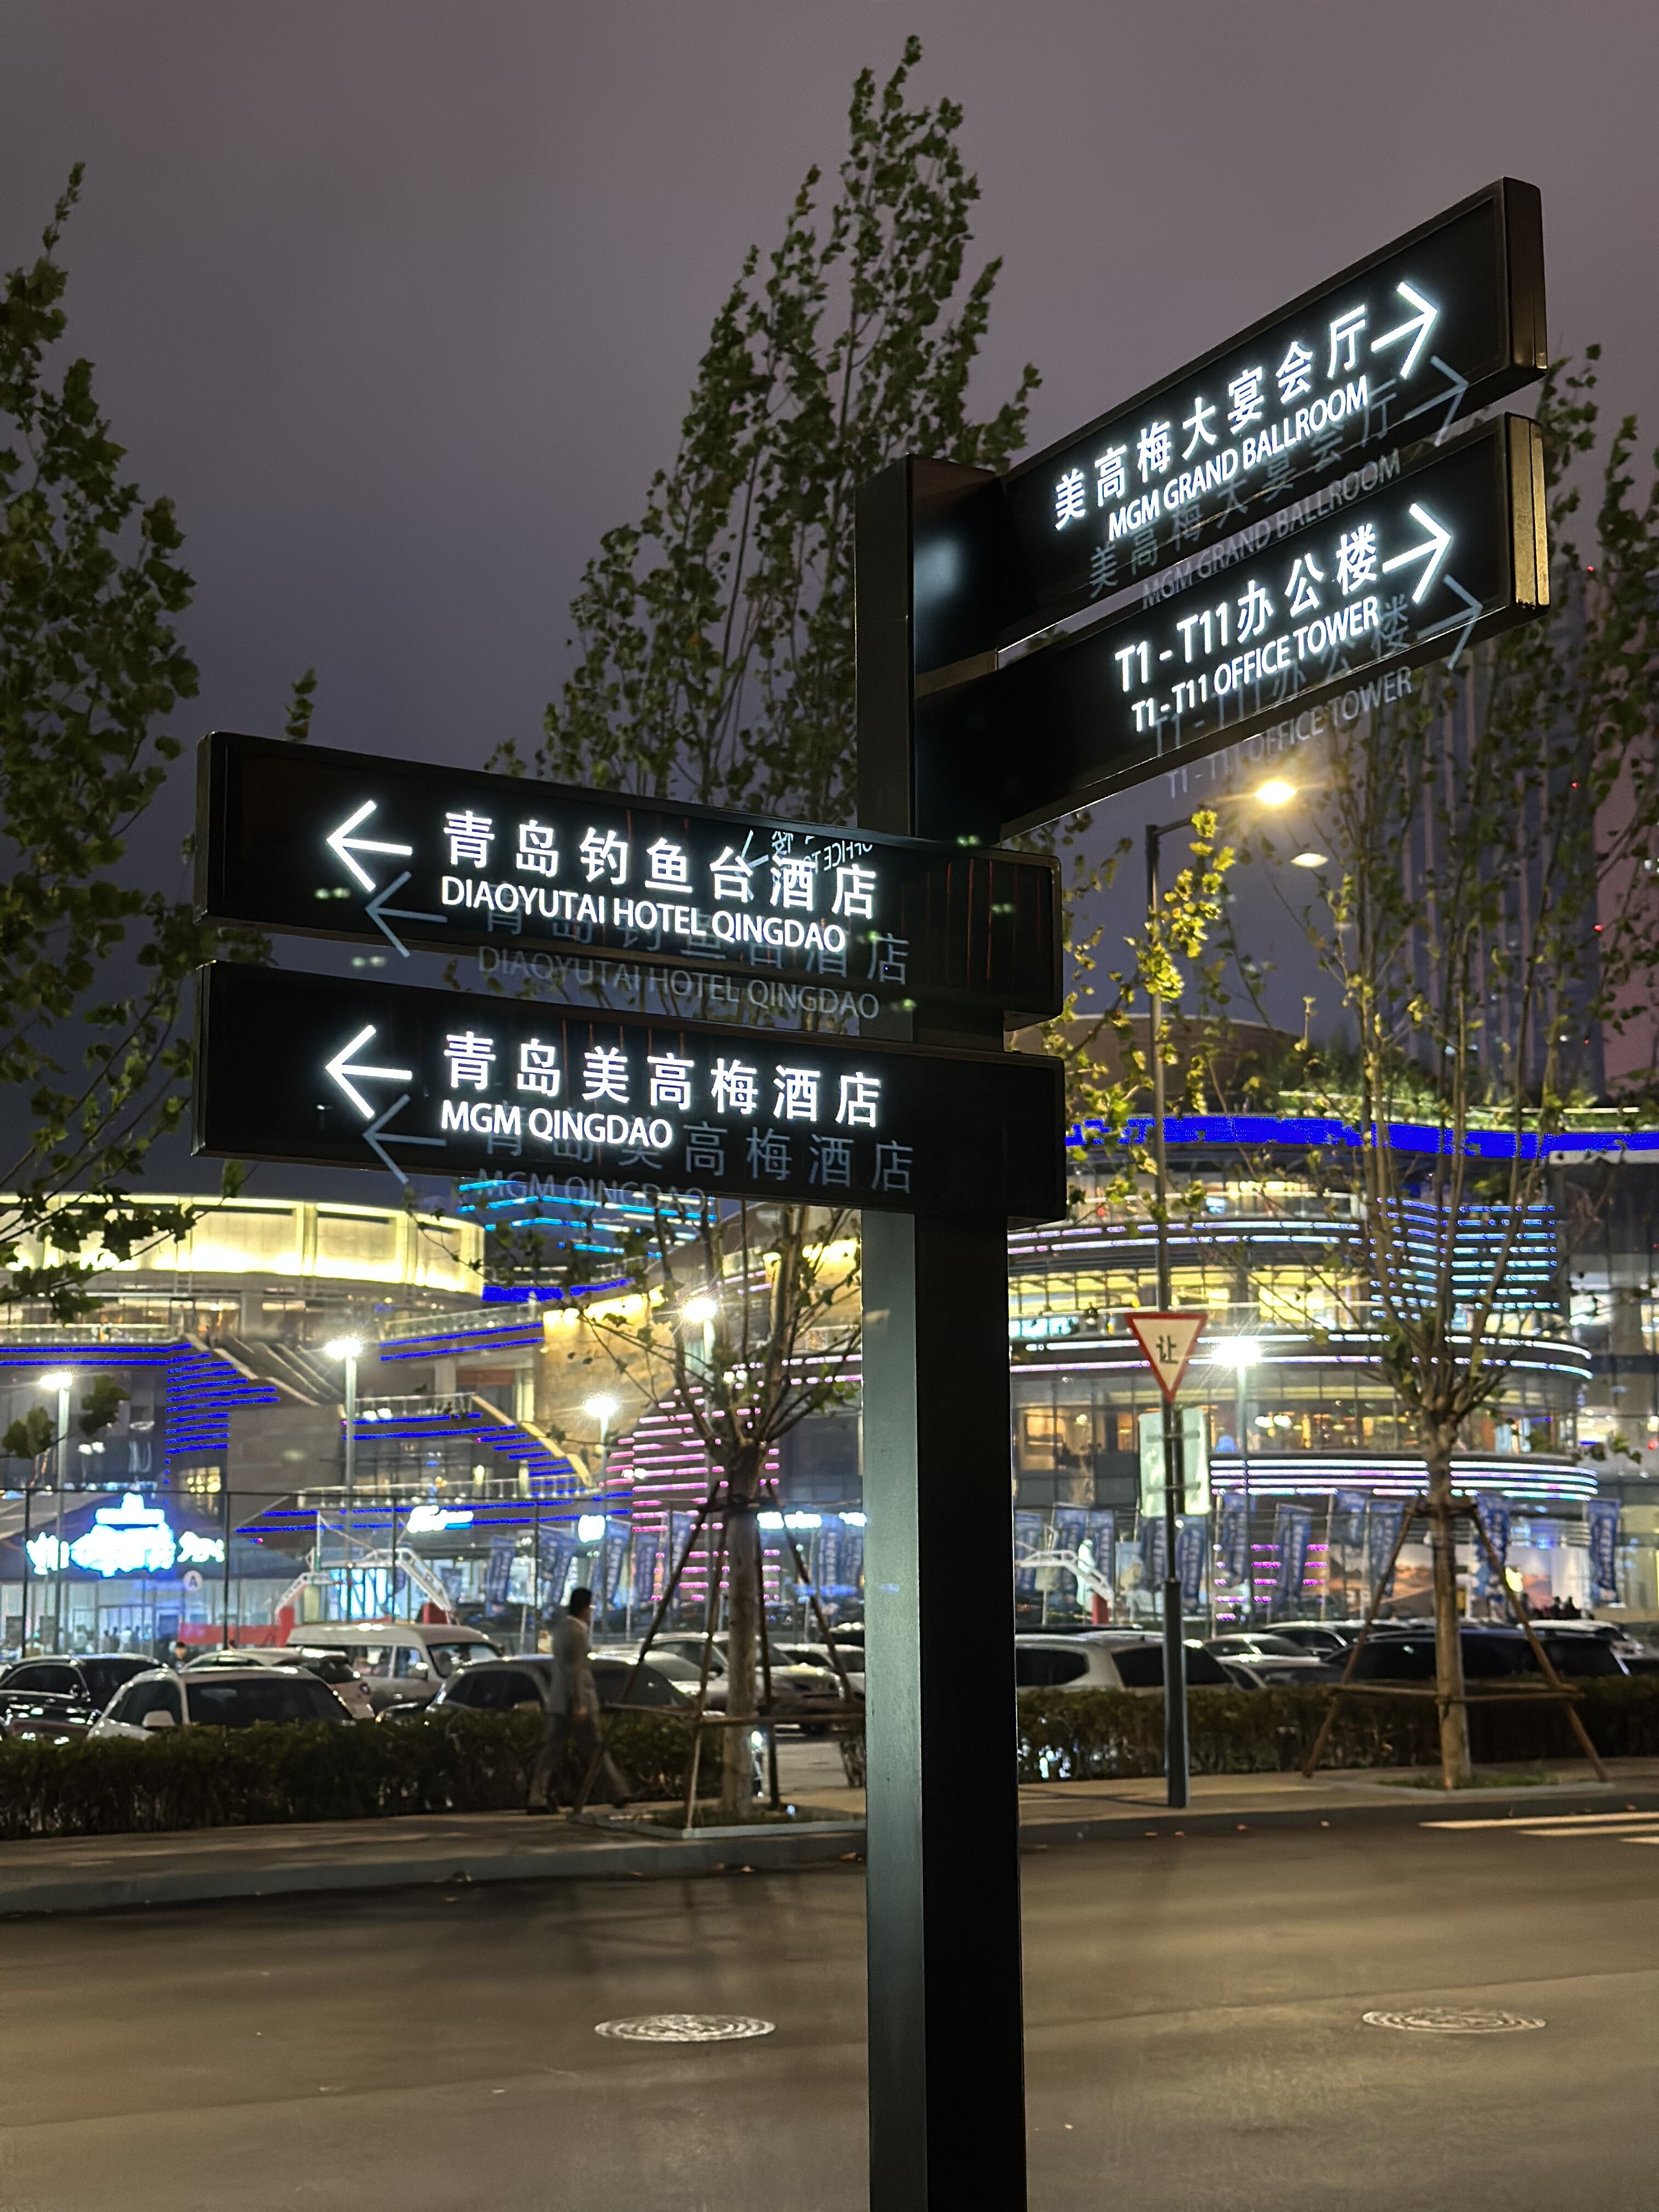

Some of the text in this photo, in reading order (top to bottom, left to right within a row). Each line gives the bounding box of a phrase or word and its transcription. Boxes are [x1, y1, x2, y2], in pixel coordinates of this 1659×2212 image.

[1055, 304, 1366, 531] 美高梅大宴会厅
[1109, 375, 1368, 541] MGM GRAND BALLROOM
[1214, 635, 1291, 696] OFFICE
[1293, 596, 1379, 660] TOWER
[443, 810, 876, 919] 青岛钓鱼台酒店
[442, 876, 605, 924] DIAOYUTAI
[614, 898, 707, 937] HOTEL
[712, 910, 845, 952] QINGDAO
[441, 1099, 673, 1148] MGM QINGDAO
[443, 1031, 880, 1127] 青岛美高梅酒店
[1155, 1334, 1179, 1364] 让
